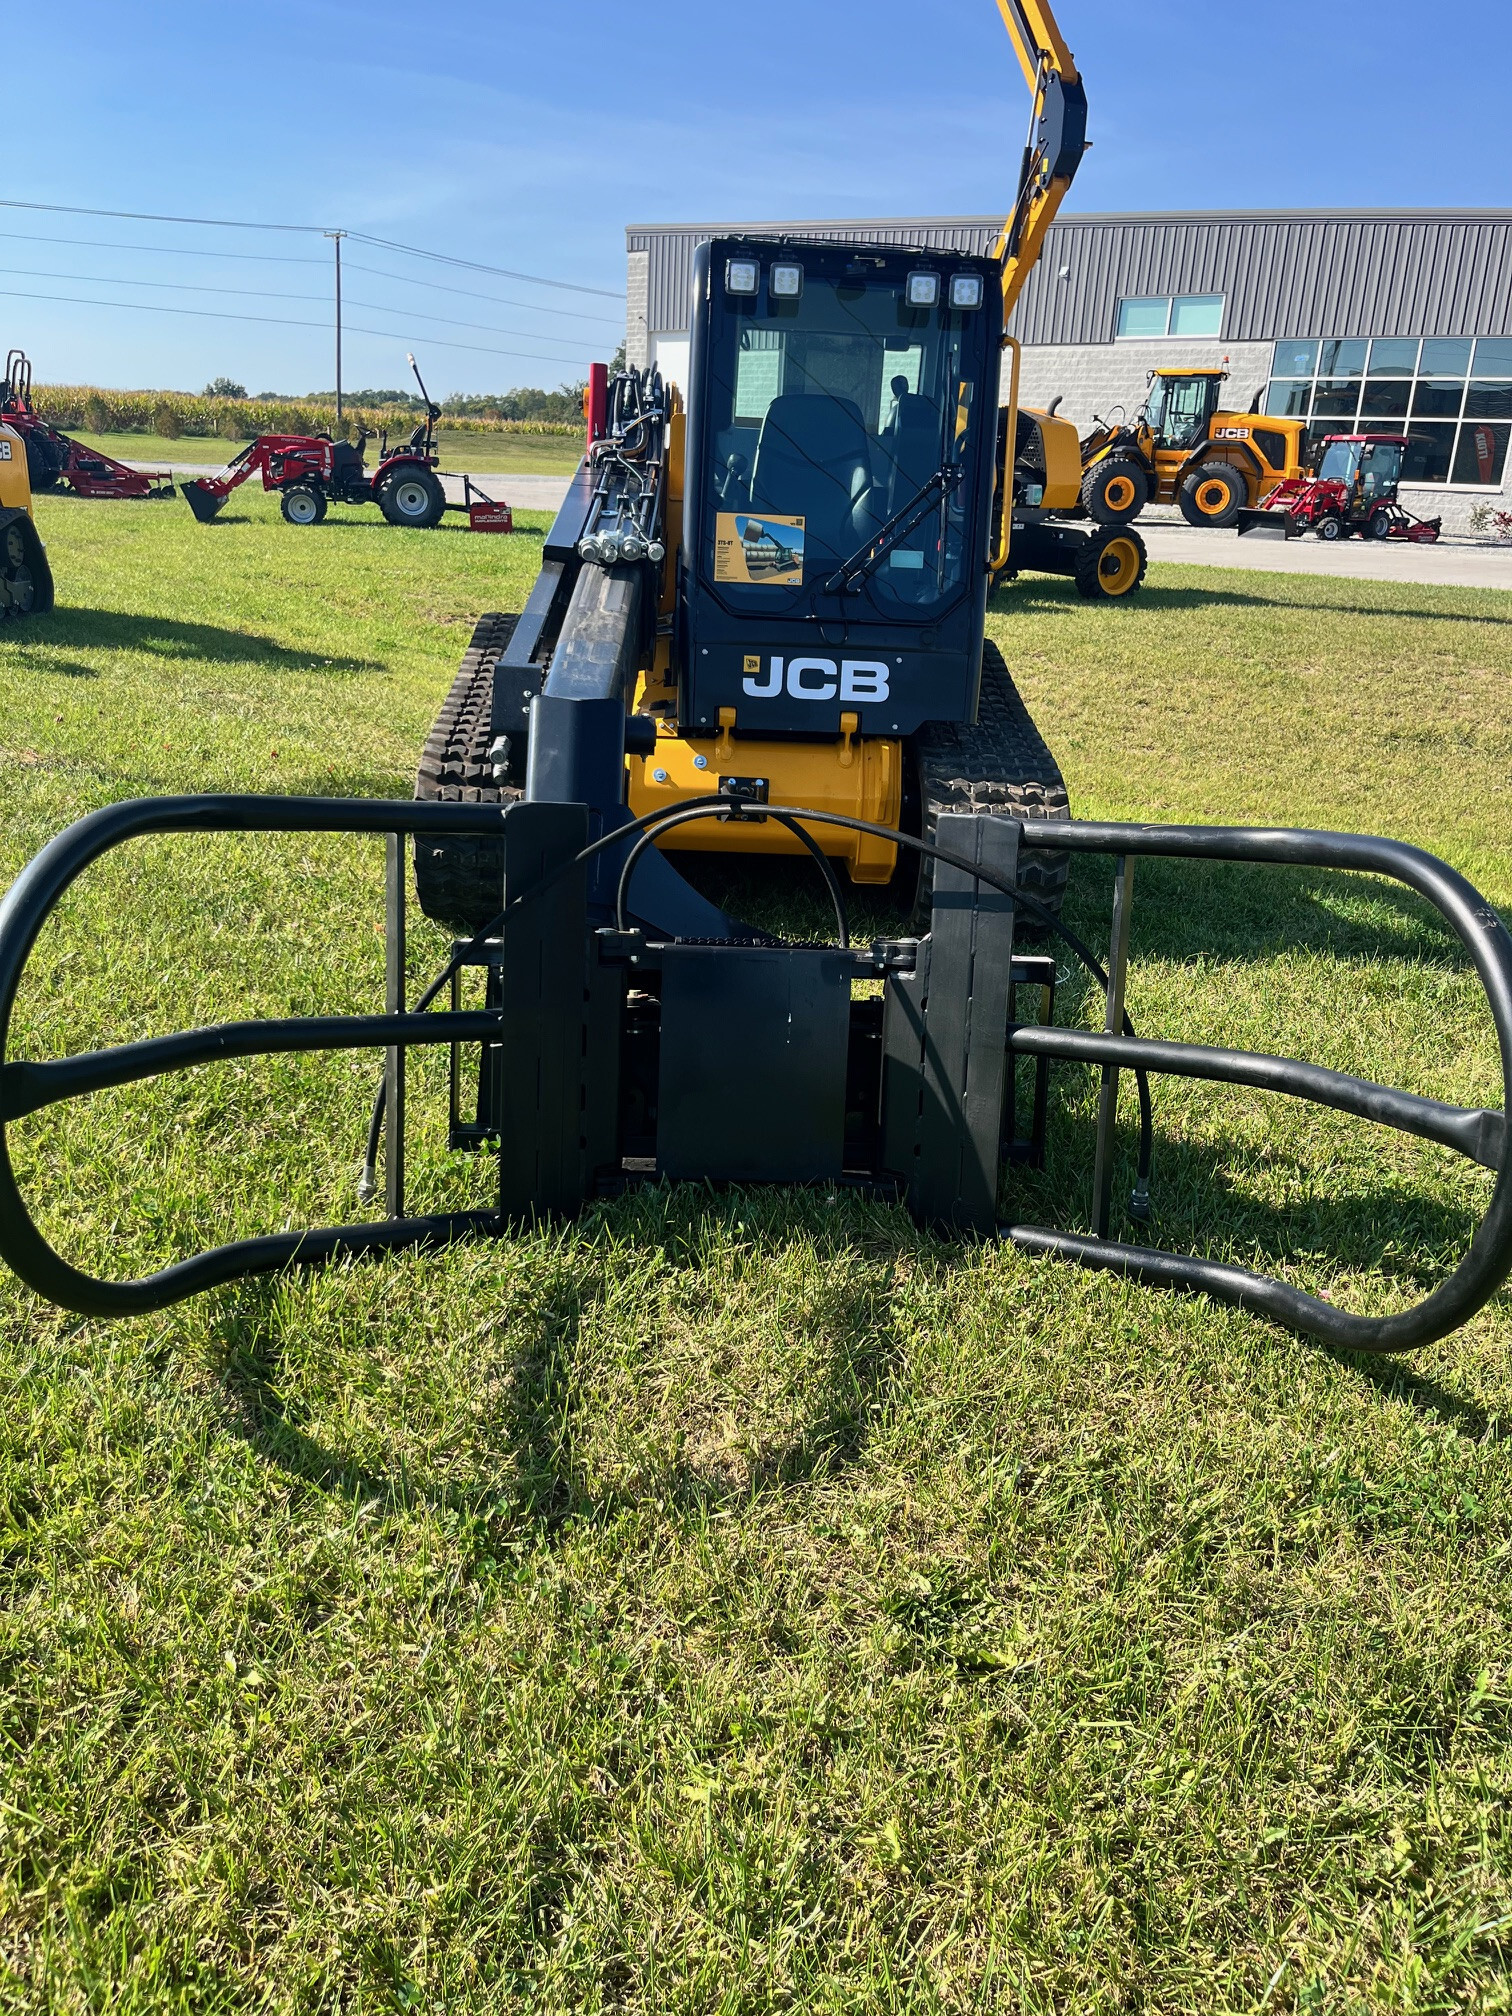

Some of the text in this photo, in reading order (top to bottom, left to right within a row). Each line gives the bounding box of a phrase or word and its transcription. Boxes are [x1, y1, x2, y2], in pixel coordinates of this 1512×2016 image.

[1215, 428, 1249, 438] JCB
[1475, 433, 1488, 459] KIOTI
[742, 656, 890, 703] JCB
